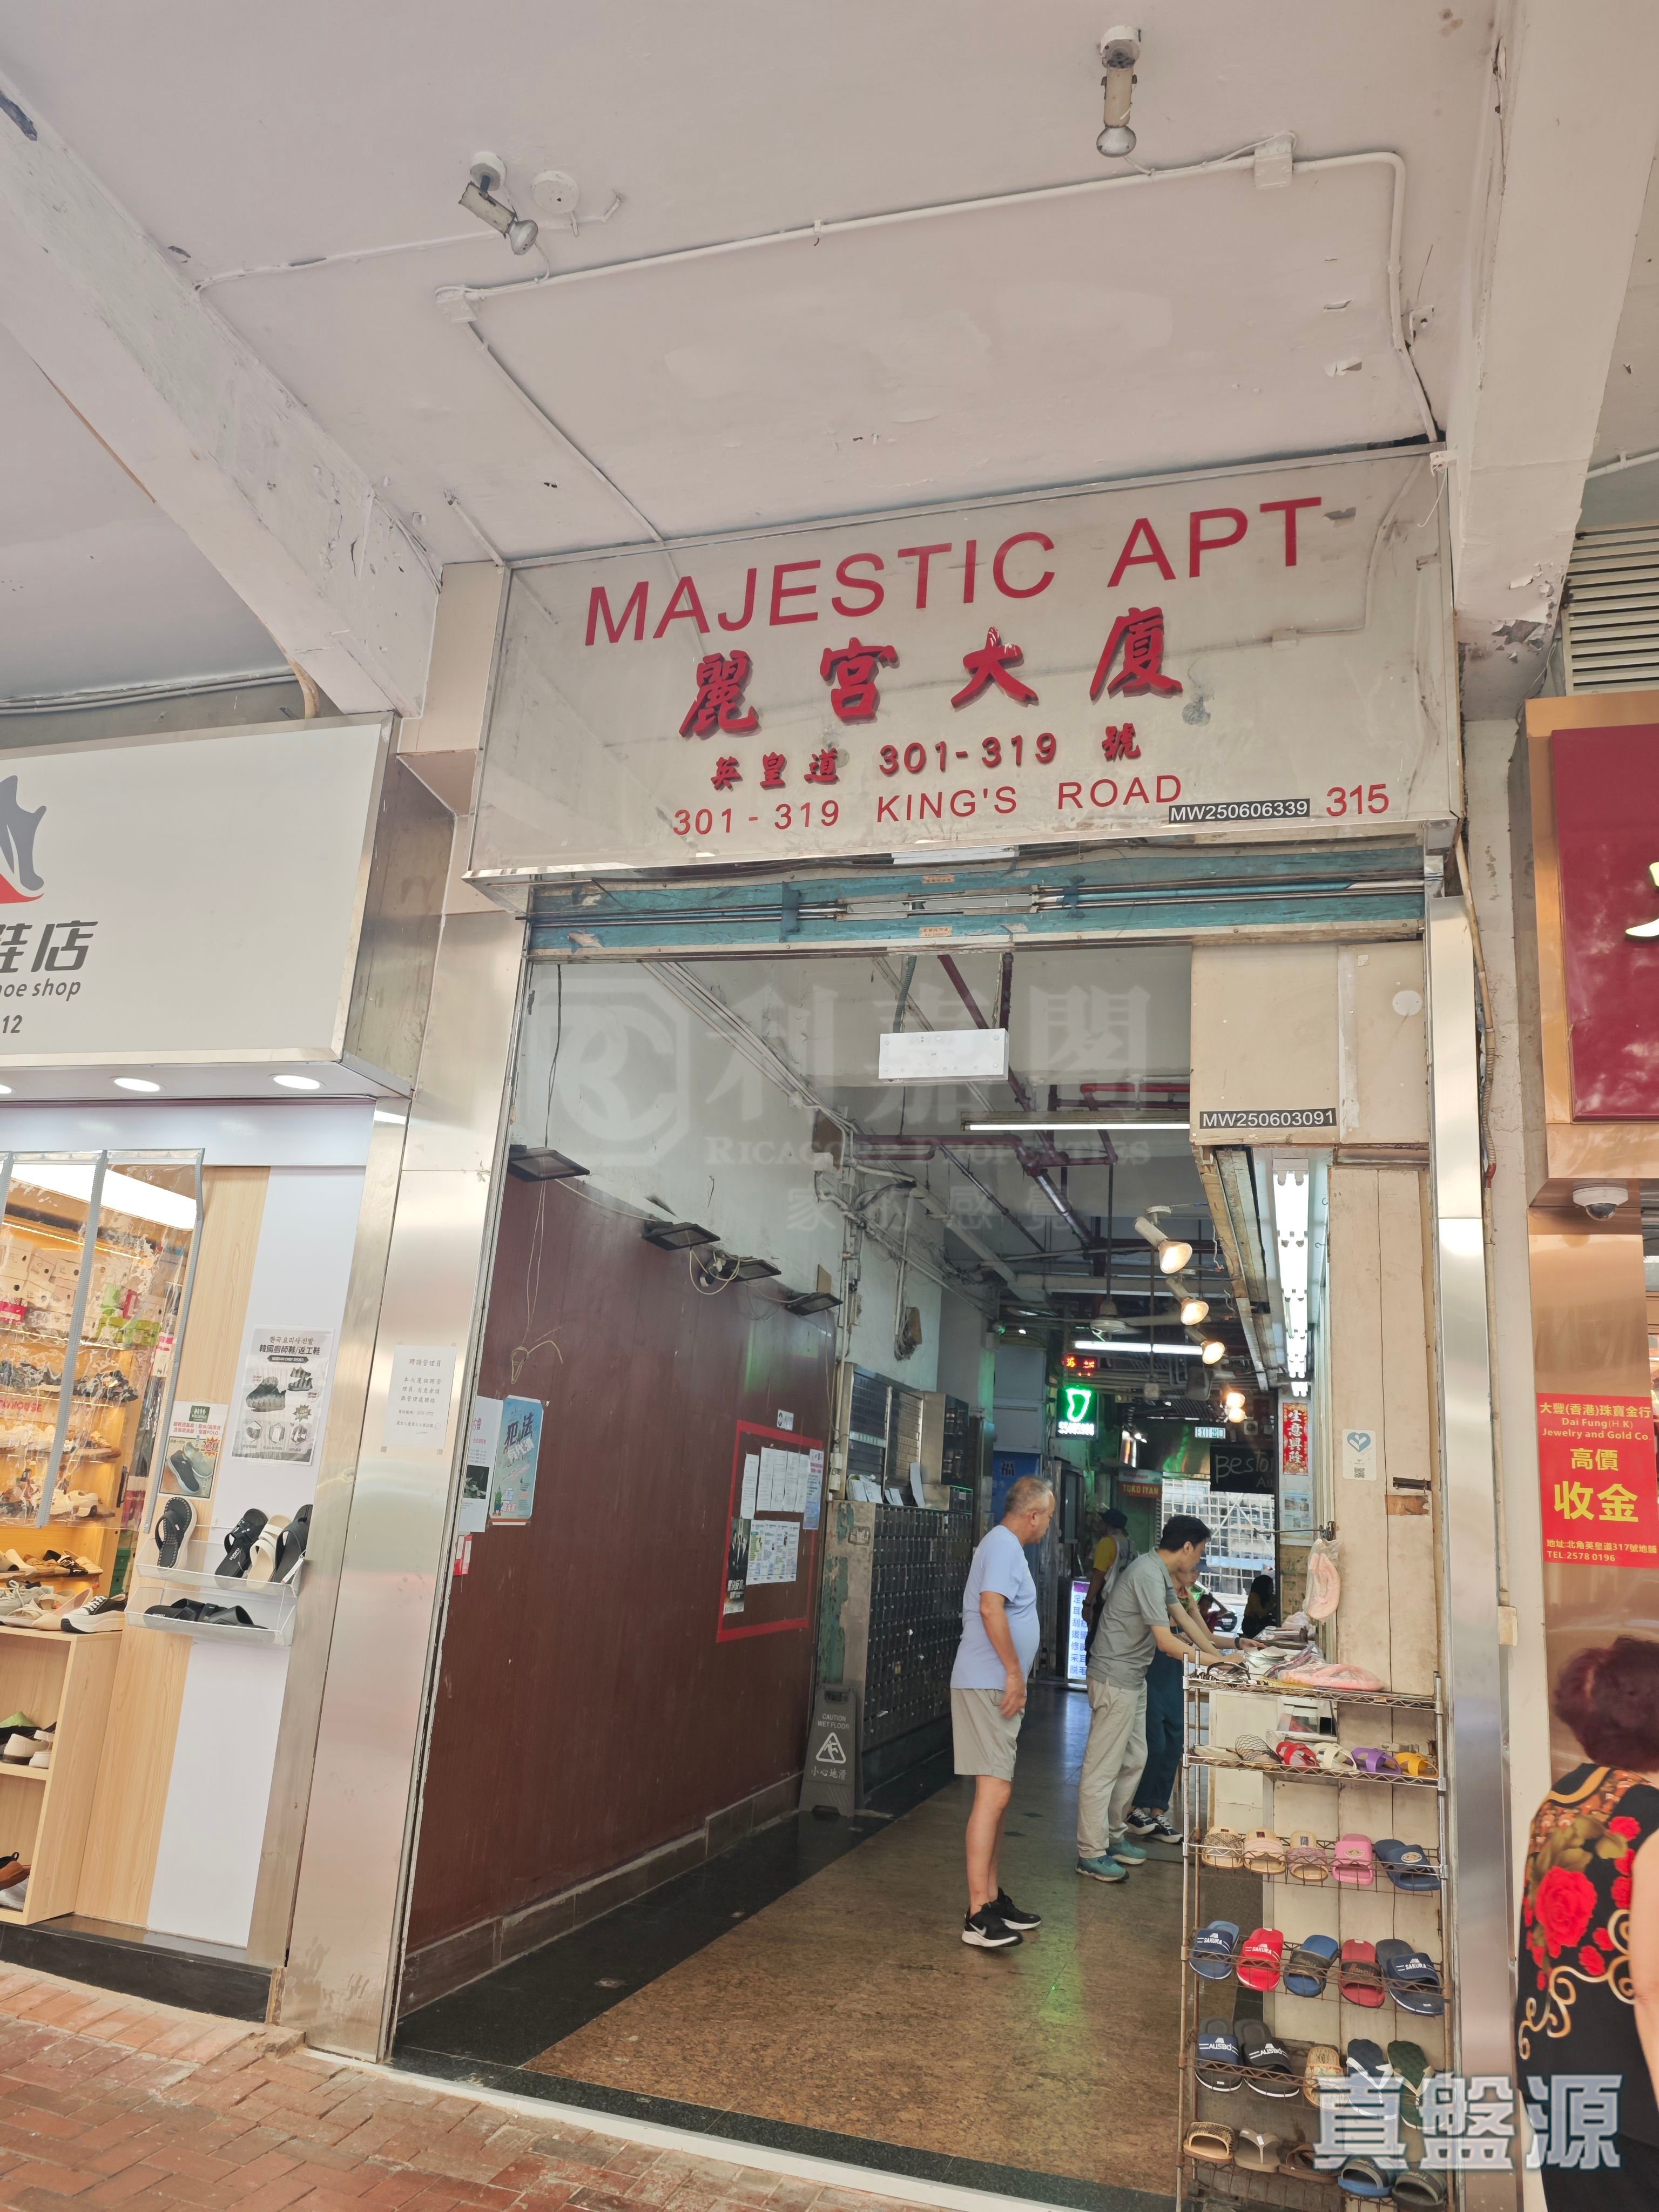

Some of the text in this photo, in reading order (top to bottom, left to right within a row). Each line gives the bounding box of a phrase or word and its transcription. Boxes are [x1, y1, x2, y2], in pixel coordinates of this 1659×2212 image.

[585, 496, 1321, 646] MAJESTIC APT
[679, 606, 1183, 738] 麗宮大廈
[710, 722, 1141, 790] 英皇道 301-319 號
[673, 808, 732, 835] 301
[774, 799, 839, 830] 319
[876, 786, 1017, 822] KING'S
[1057, 775, 1182, 810] ROAD
[1326, 783, 1390, 816] 315
[1170, 800, 1309, 821] MW250606339
[0, 977, 81, 1002] oe shop
[1203, 1110, 1333, 1127] MW250603091
[282, 1337, 300, 1345] 요리사
[409, 1358, 442, 1367] 聘請管理員
[1539, 1402, 1651, 1419] 大豐(香港)珠寶金行
[1562, 1418, 1579, 1426] Dai
[1196, 1427, 1224, 1438] EXIT 出口
[1287, 1410, 1304, 1464] 生意興隆
[1542, 1428, 1582, 1440] Jewelry
[1584, 1431, 1604, 1439] and
[1607, 1431, 1632, 1440] Gold
[1570, 1447, 1619, 1471] 高價
[1123, 1484, 1159, 1495] TOKO IYAN
[1554, 1481, 1639, 1522] 收金
[1591, 1553, 1616, 1562] 0196
[822, 1713, 847, 1722] CAUTION
[830, 1722, 849, 1730] FLOOR
[811, 1765, 847, 1781] 小心地滑
[1203, 1937, 1222, 1946] SAKURA
[1252, 1946, 1272, 1955] SAKURA
